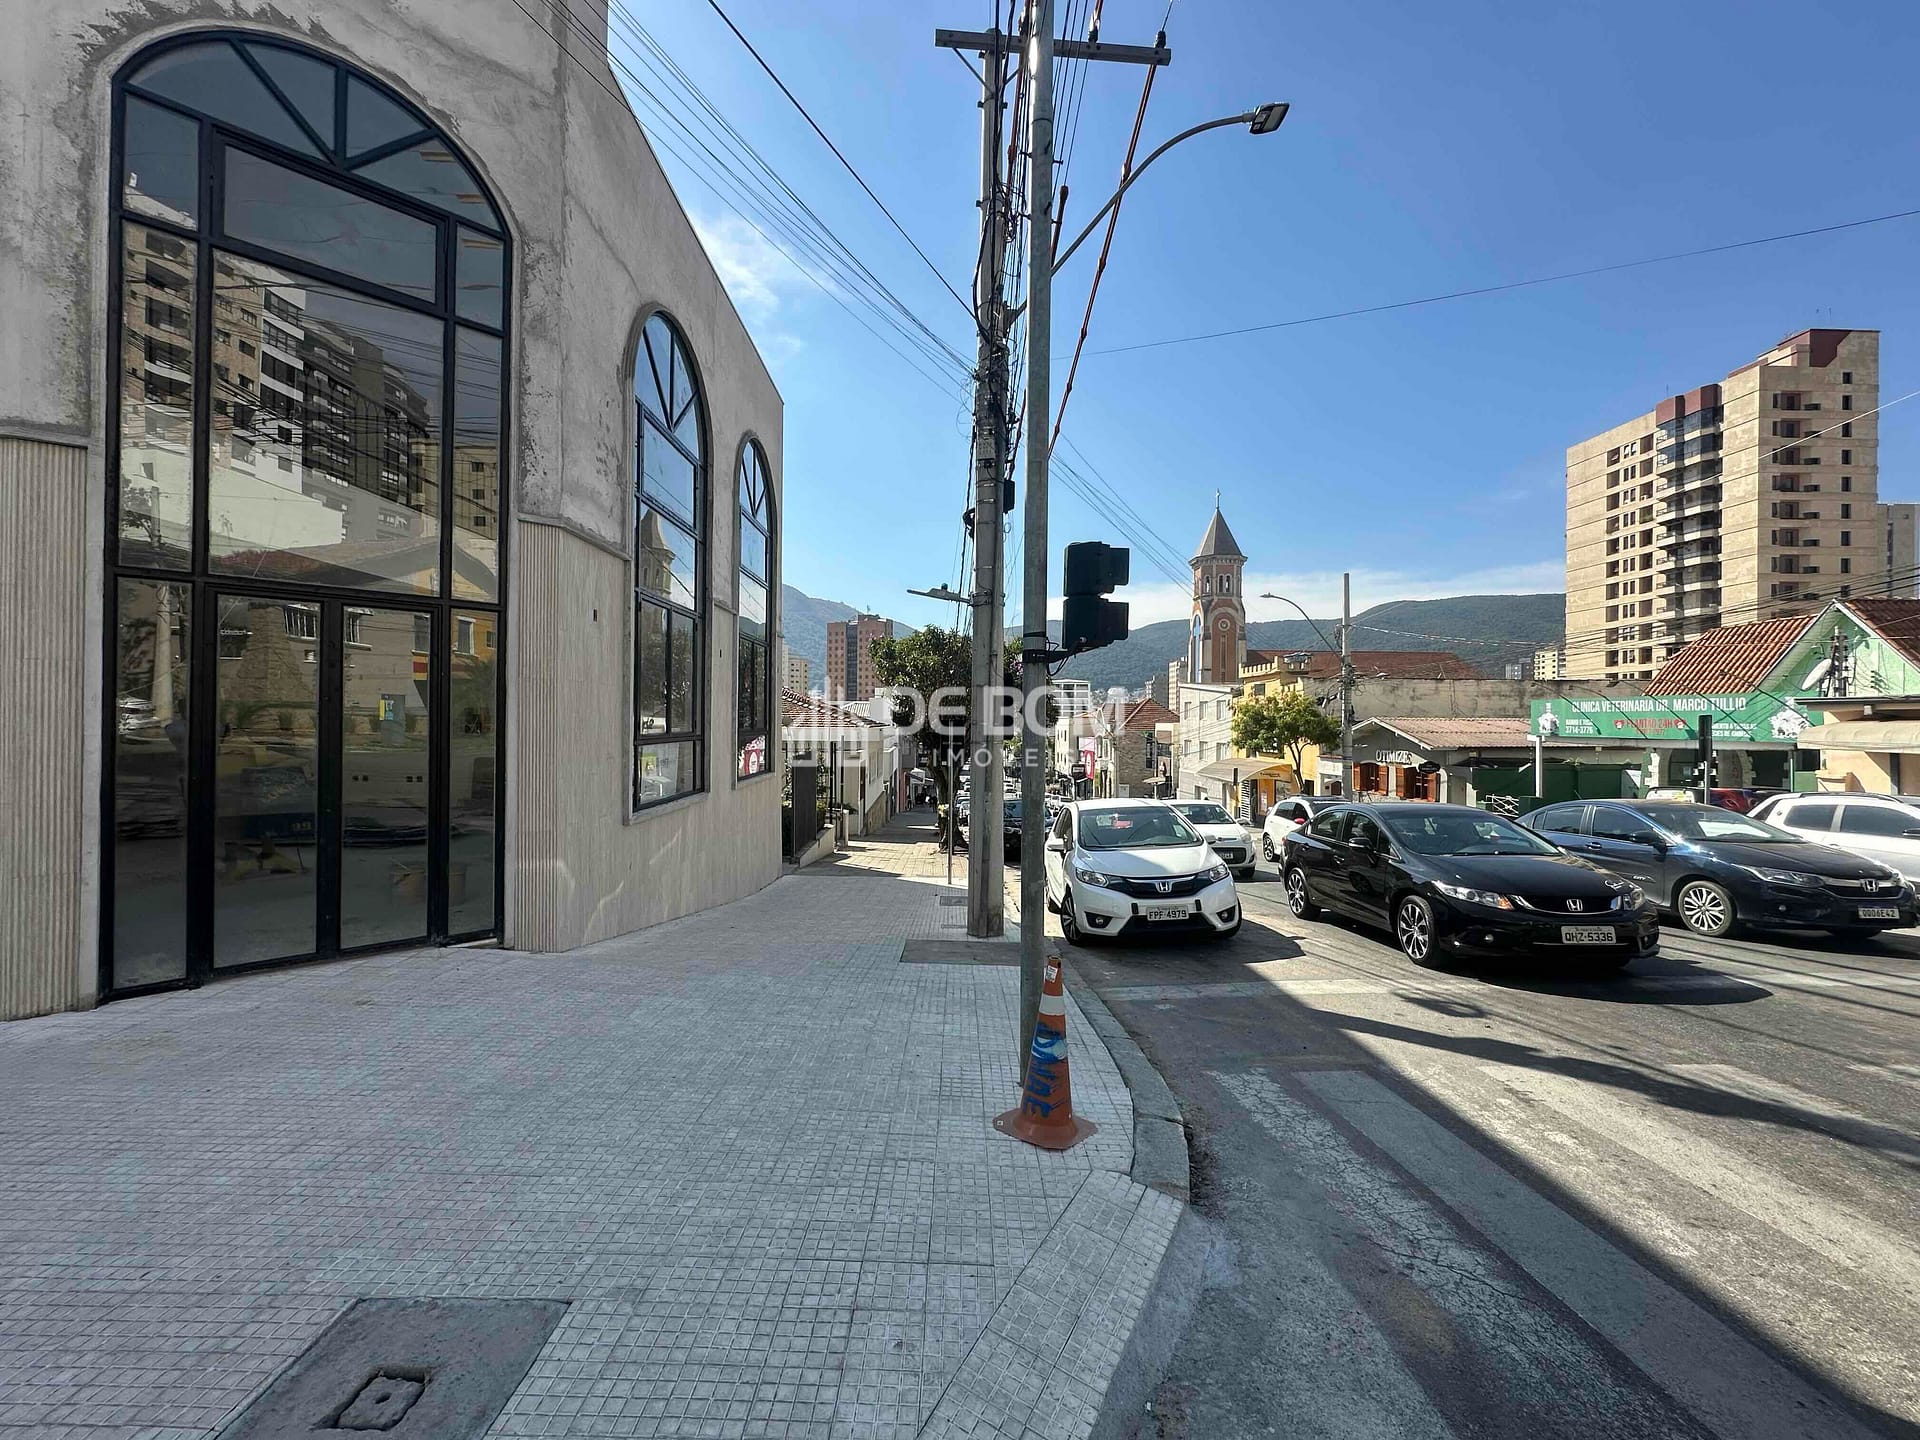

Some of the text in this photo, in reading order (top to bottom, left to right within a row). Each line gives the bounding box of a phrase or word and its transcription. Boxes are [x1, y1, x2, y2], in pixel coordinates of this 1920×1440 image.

[1572, 701, 1600, 713] CLINICA
[1602, 699, 1654, 712] VETERINARIA
[1673, 698, 1707, 711] MARCO
[1711, 697, 1747, 710] TULLIO
